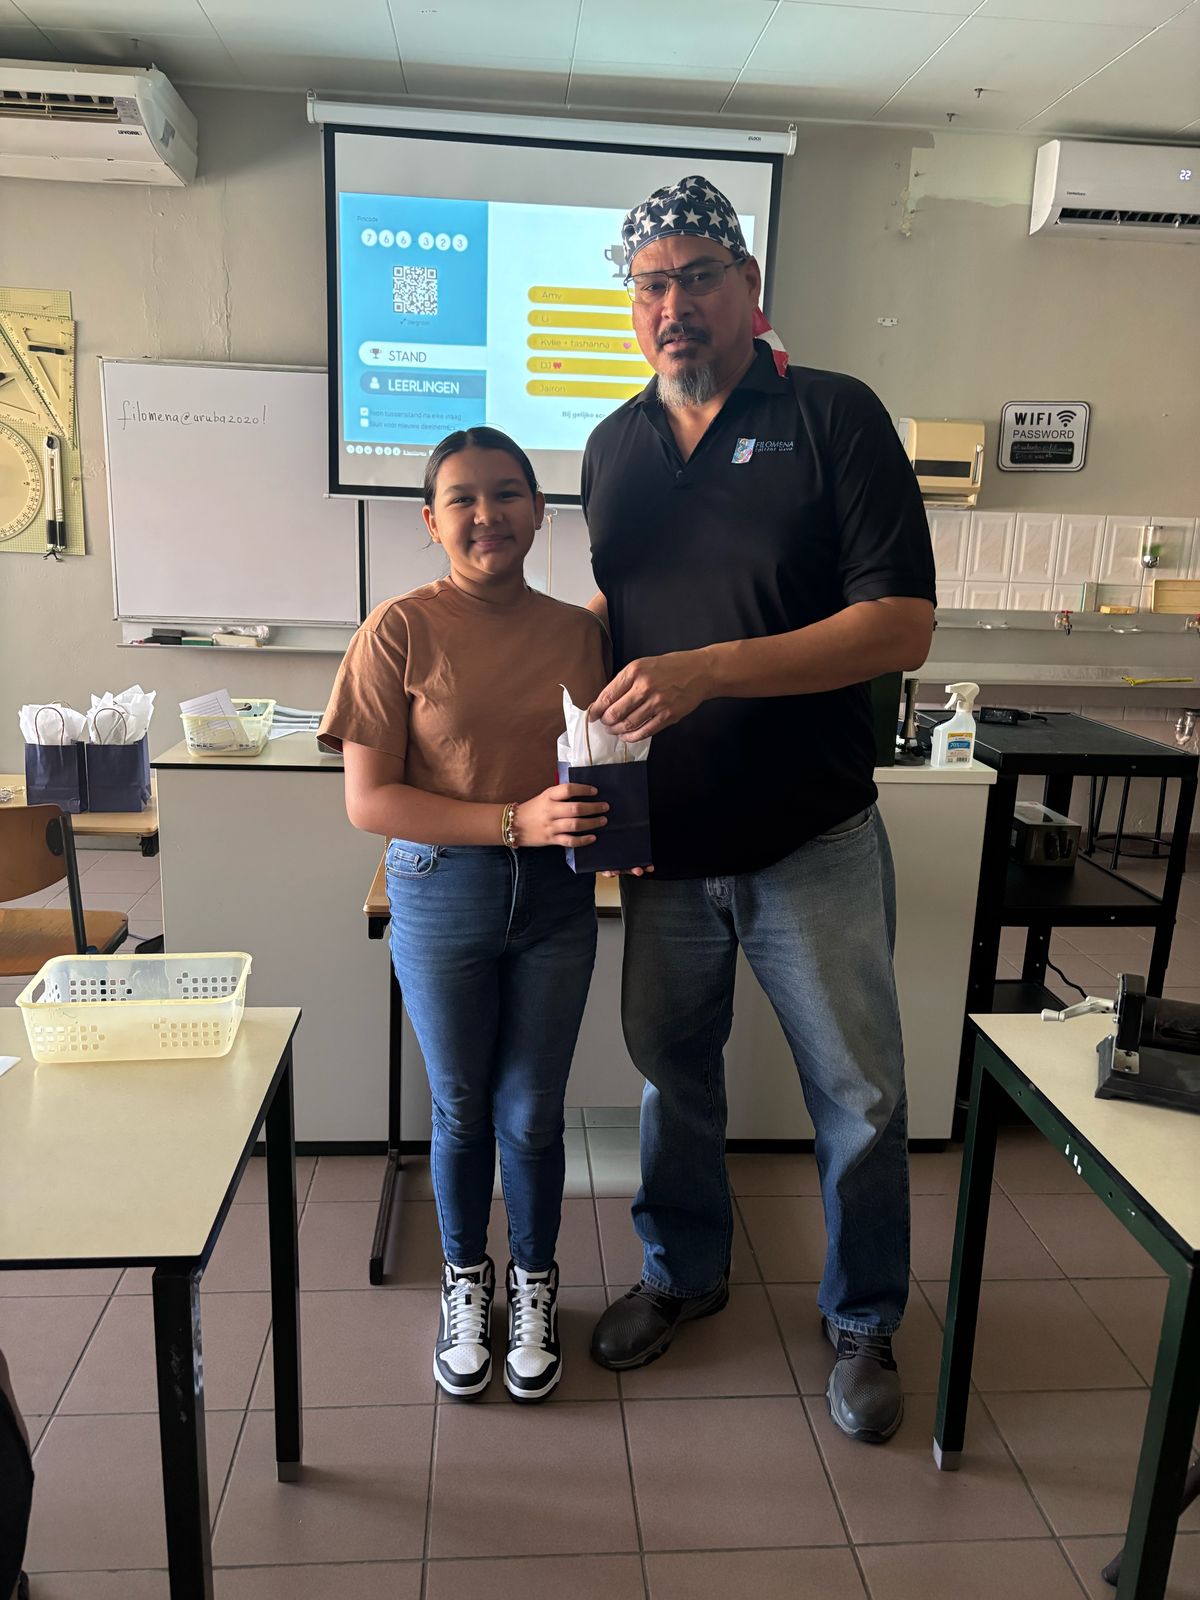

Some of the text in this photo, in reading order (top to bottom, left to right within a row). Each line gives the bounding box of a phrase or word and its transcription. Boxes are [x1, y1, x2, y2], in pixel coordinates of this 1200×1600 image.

[1179, 169, 1192, 180] 22
[388, 350, 427, 363] STAND
[388, 379, 460, 395] LEERLINGEN
[1014, 412, 1052, 426] WIFI
[1012, 430, 1075, 439] PASSWORD
